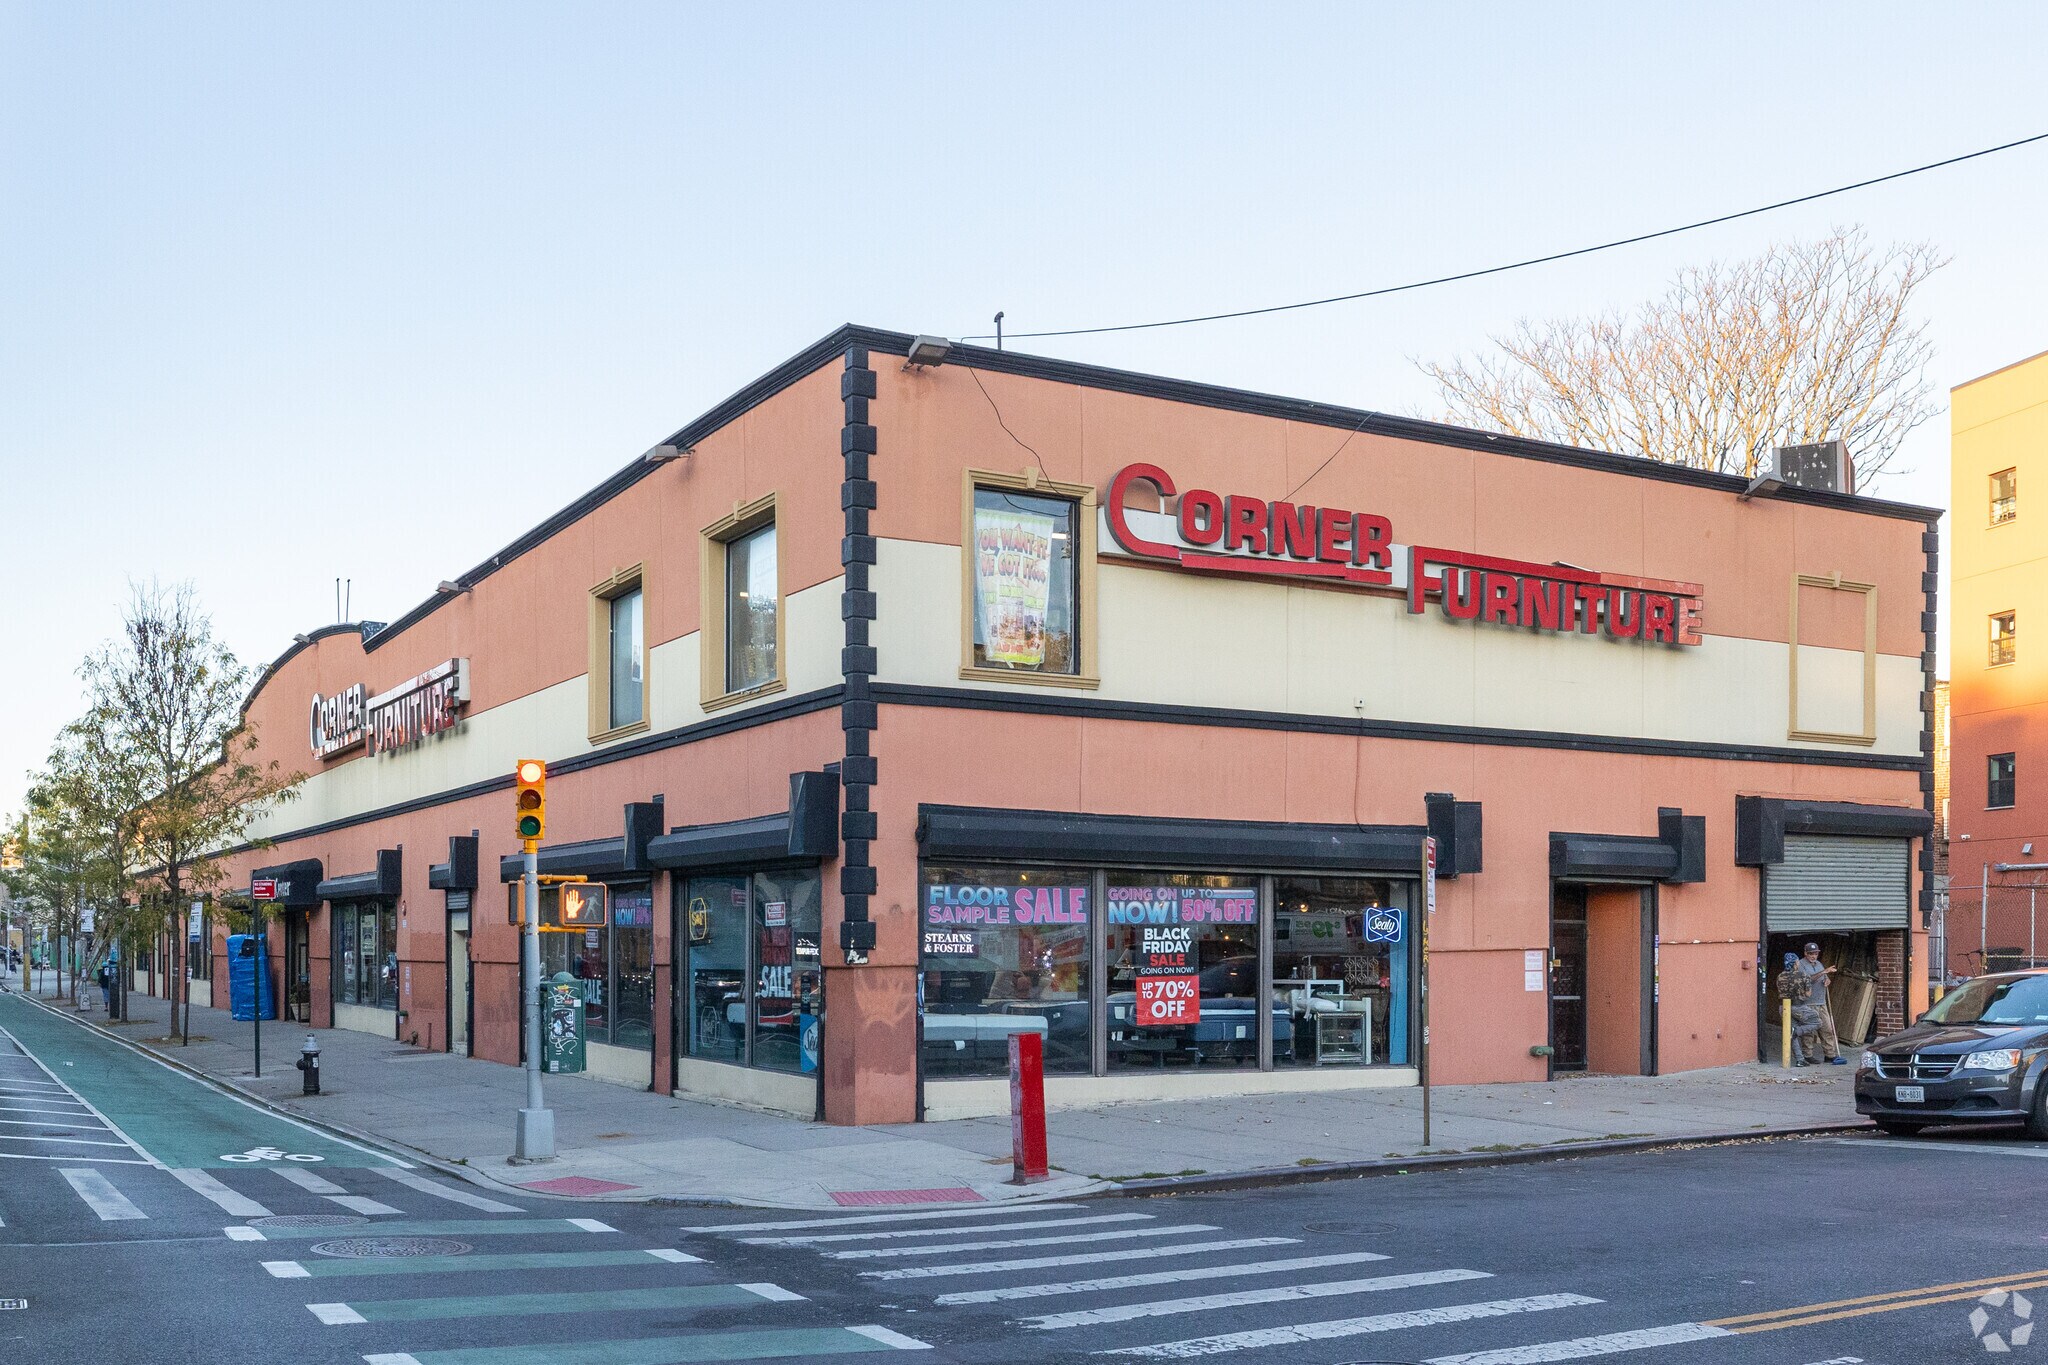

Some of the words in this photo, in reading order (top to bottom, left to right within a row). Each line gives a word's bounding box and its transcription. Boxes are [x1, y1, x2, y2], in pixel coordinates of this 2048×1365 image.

[1104, 462, 1393, 569] CORNER
[1407, 545, 1704, 647] FURNITURE
[366, 658, 459, 757] FURNITURE
[310, 683, 364, 760] CORNER
[929, 885, 1009, 906] FLOOR
[1108, 888, 1152, 900] GOING
[1156, 888, 1177, 900] ON
[1181, 889, 1195, 898] UP
[1198, 889, 1214, 898] TO
[1014, 887, 1087, 923] SALE
[1108, 901, 1178, 924] NOW!
[1181, 899, 1222, 922] 50%
[1223, 899, 1255, 922] OFF
[928, 906, 1010, 924] SAMPLE
[1144, 927, 1190, 941] BLACK
[1371, 917, 1395, 933] Sealy
[925, 933, 972, 943] STEARNS
[1142, 940, 1193, 954] FRIDAY
[924, 944, 932, 953] &
[933, 944, 973, 953] FOSTER
[1150, 953, 1185, 967] SALE
[1140, 967, 1163, 975] GOING
[1175, 966, 1195, 974] NOW!
[762, 966, 792, 998] SALE
[1141, 982, 1154, 991] UP
[1154, 980, 1195, 999] 70%
[1142, 990, 1154, 999] TO
[1151, 1000, 1186, 1018] OFF
